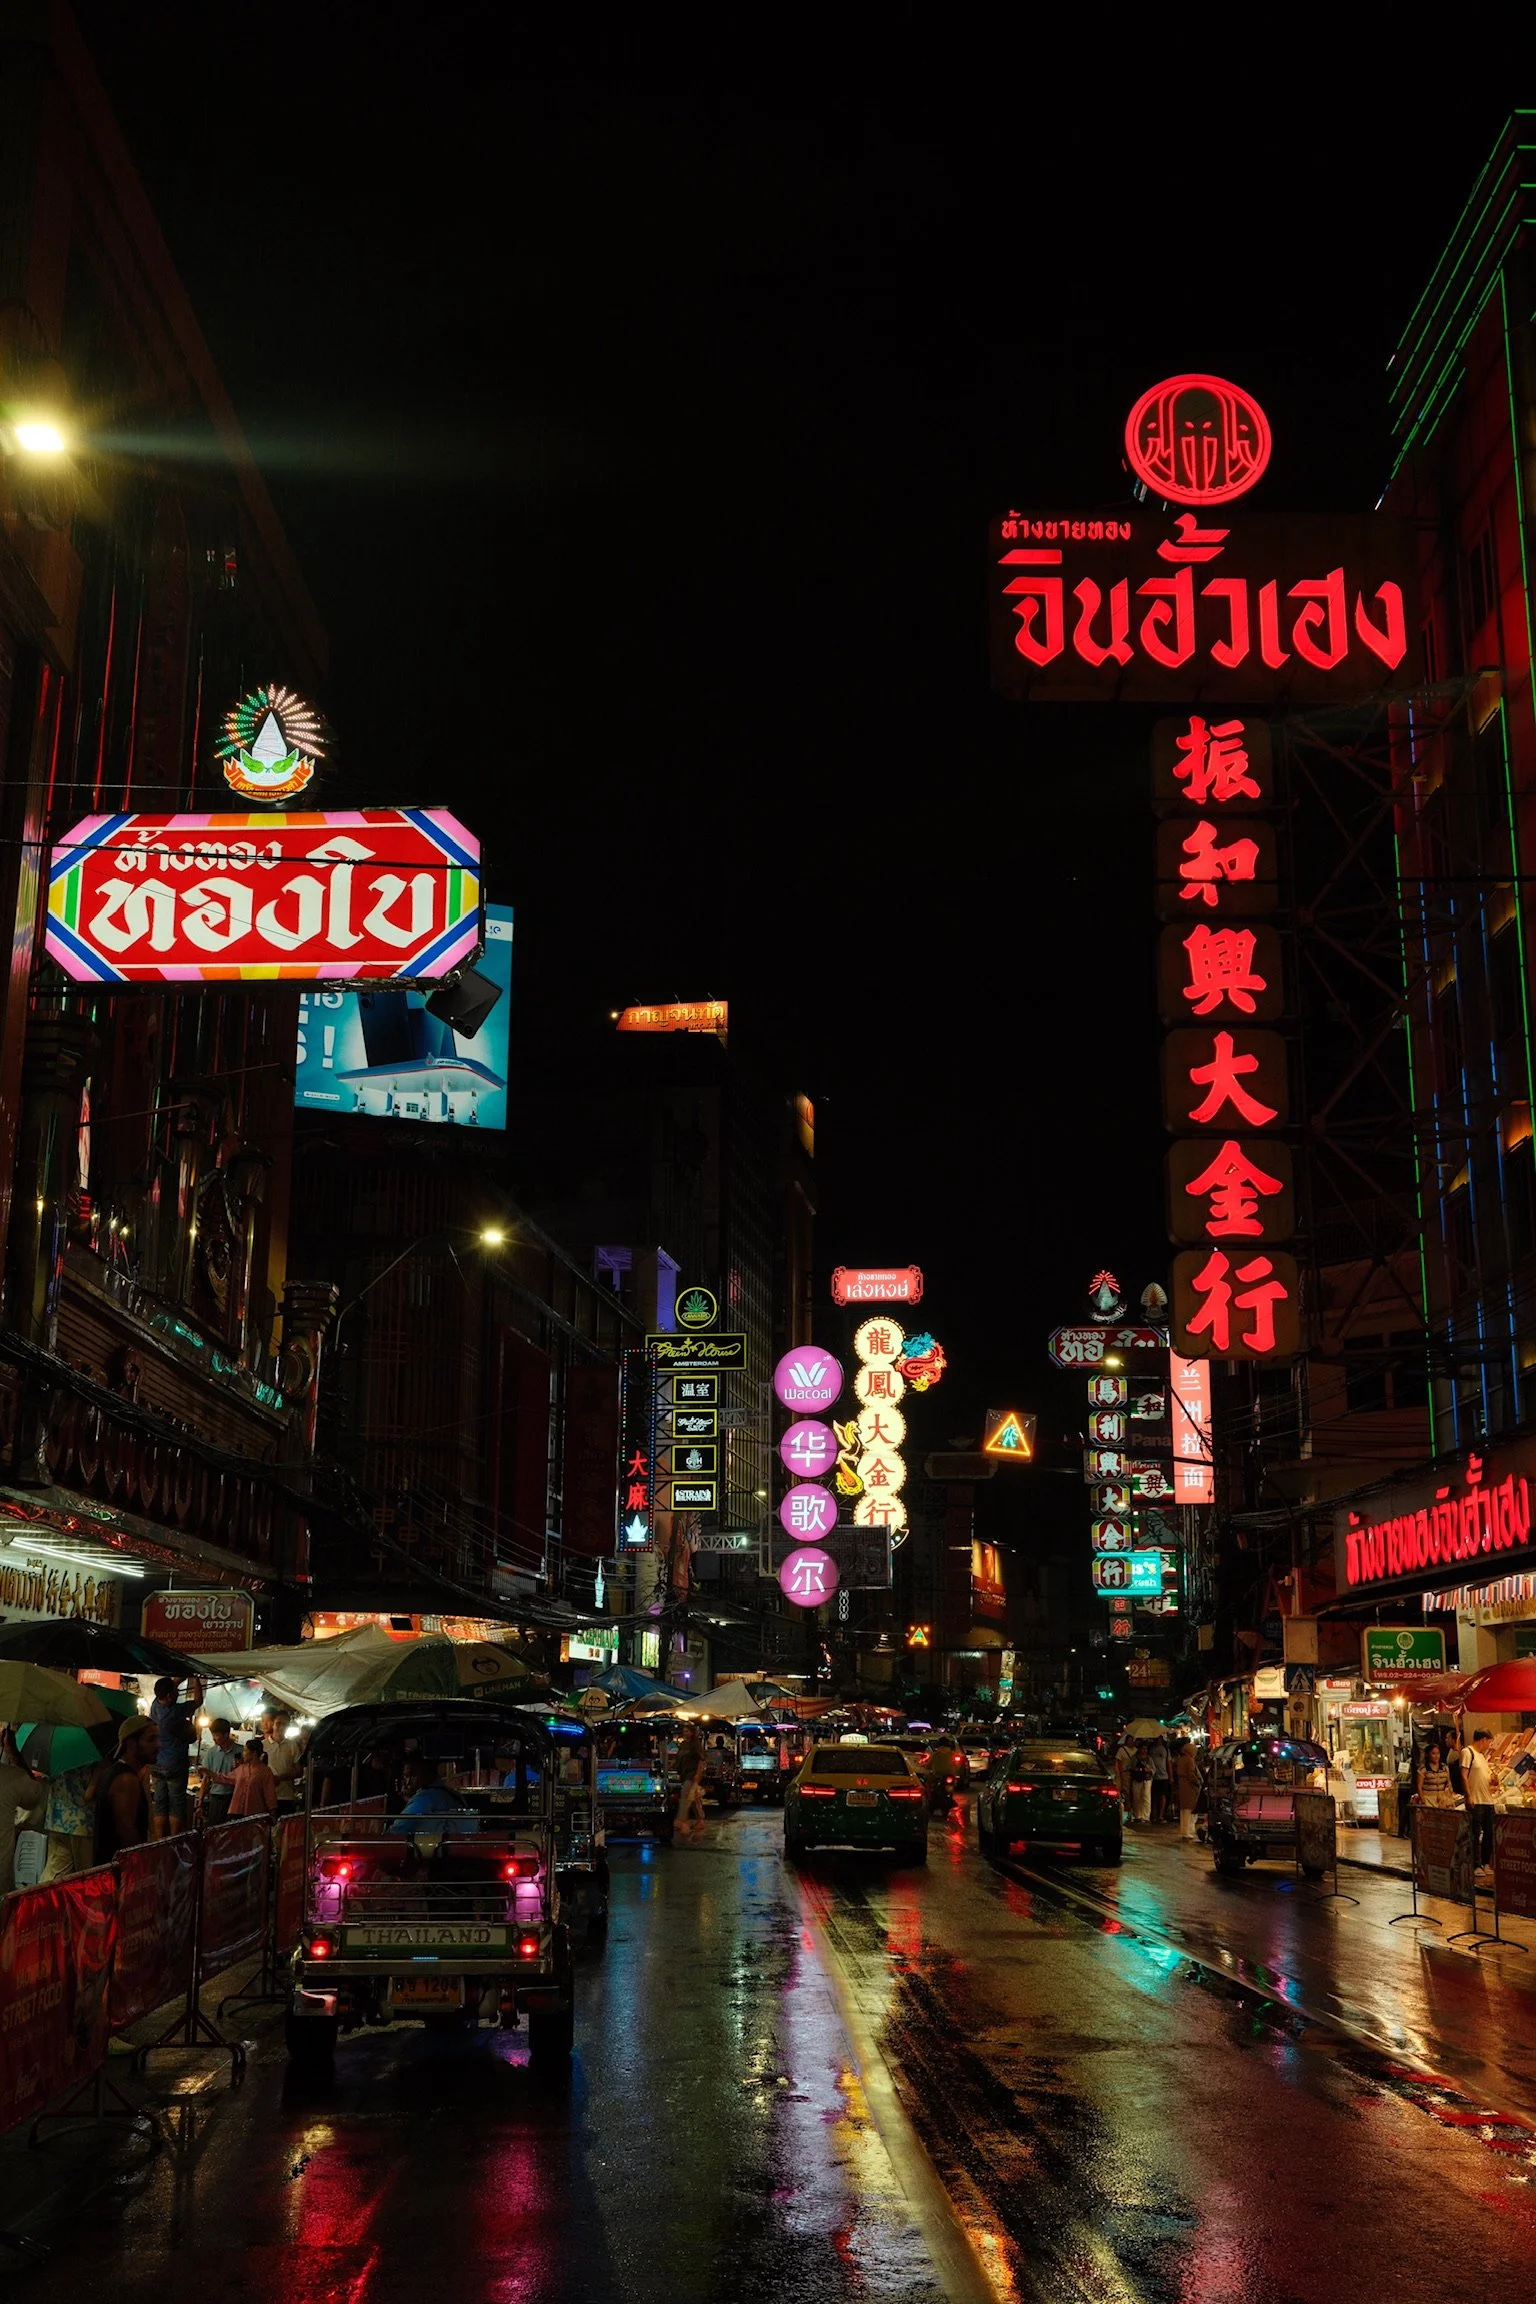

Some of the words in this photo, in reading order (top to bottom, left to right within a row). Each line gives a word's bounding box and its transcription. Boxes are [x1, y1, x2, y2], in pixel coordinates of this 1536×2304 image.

[1001, 510, 1131, 541] ห้างขายทอง
[998, 512, 1407, 671] จินฮั้วเฮง
[114, 830, 283, 872] ห้างทอง
[89, 836, 437, 953] ทองใบ
[847, 1279, 909, 1299] เล่งหงษ์
[694, 1341, 741, 1358] House
[681, 1382, 711, 1398] 温室
[784, 1387, 832, 1400] Wacoal
[863, 1326, 897, 1525] 龍鳳大金行
[1179, 1367, 1205, 1488] 兰州拉面
[627, 1451, 649, 1511] 大麻
[790, 1431, 827, 1596] 华歌尔
[164, 1594, 233, 1620] ทองใบ
[1371, 1650, 1442, 1670] จินฮั้วเฮง
[362, 1928, 492, 1944] THAILAND
